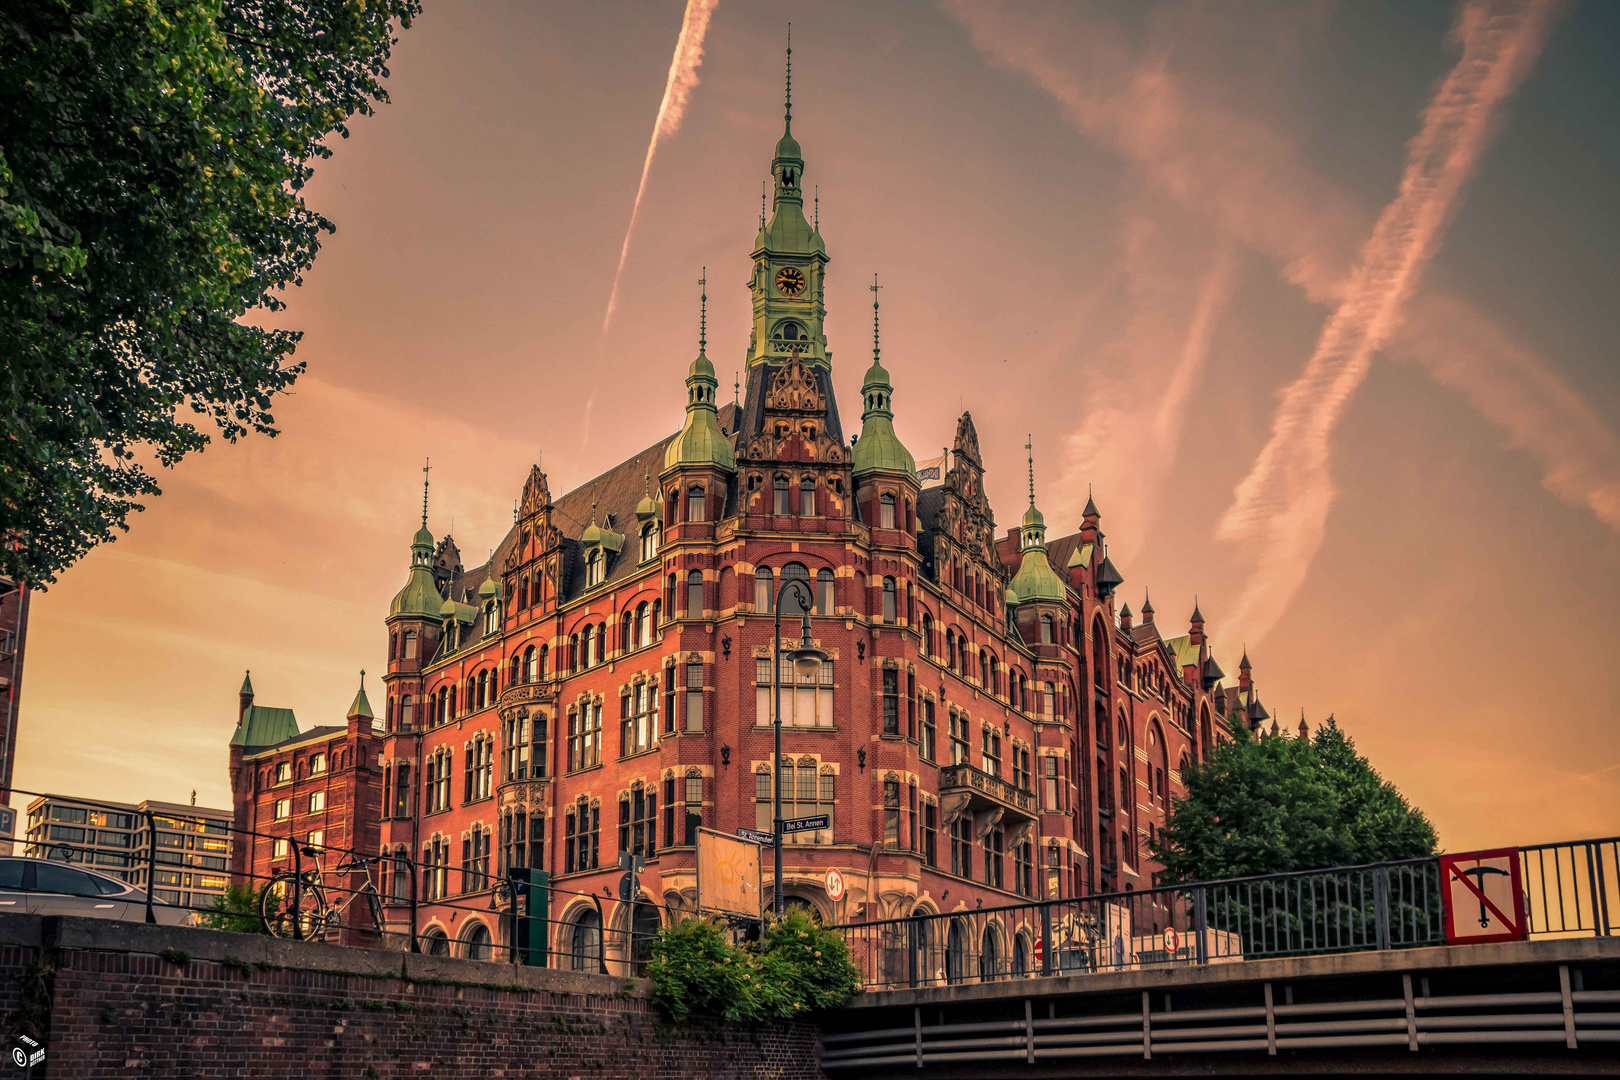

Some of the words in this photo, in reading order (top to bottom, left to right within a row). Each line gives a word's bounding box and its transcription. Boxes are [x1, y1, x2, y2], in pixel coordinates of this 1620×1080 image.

[1, 813, 10, 829] P
[786, 822, 796, 830] Bei
[805, 820, 824, 828] Annen
